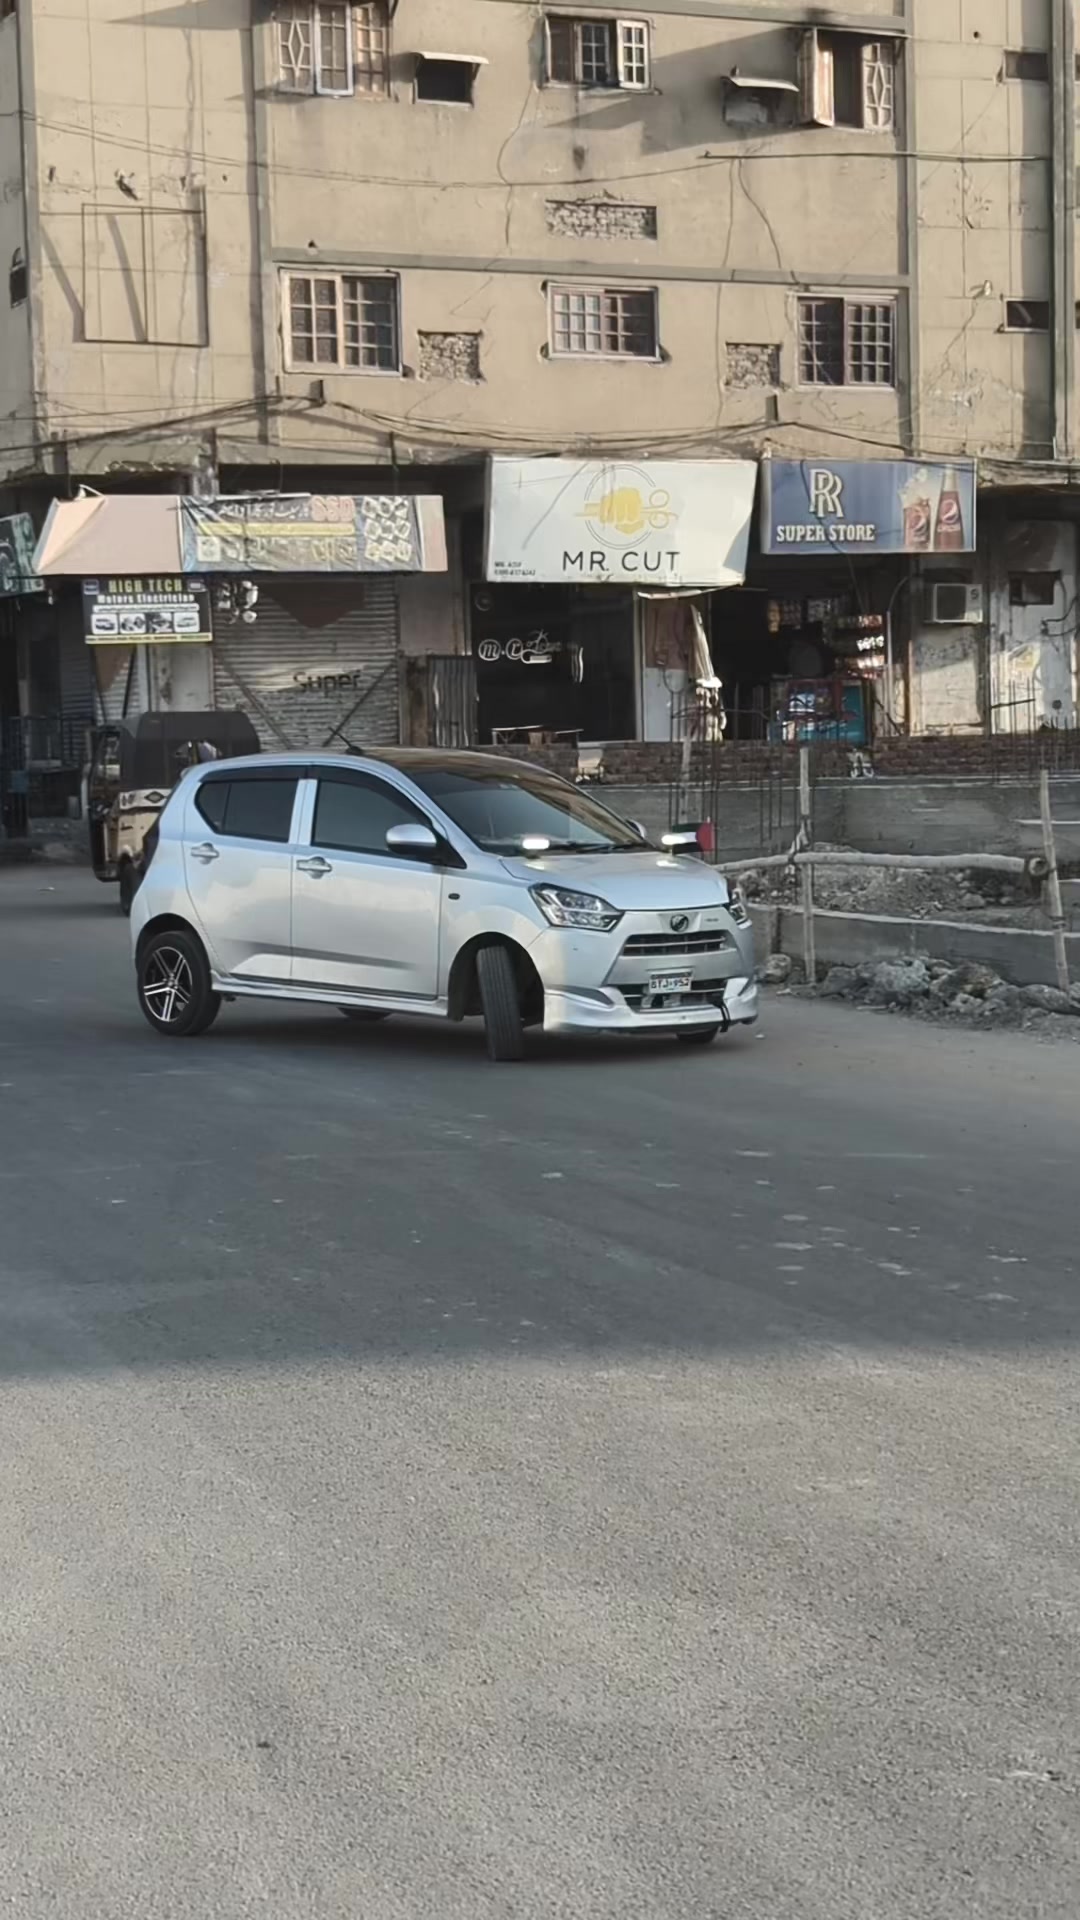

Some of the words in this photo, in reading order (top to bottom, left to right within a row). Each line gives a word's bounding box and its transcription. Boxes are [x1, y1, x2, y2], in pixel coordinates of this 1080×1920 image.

[776, 524, 826, 542] SUPER
[828, 523, 876, 541] STORE
[562, 550, 610, 572] MR.
[621, 550, 681, 572] CUT
[108, 579, 144, 593] HIGH
[148, 579, 183, 593] TECH
[293, 670, 362, 698] Super
